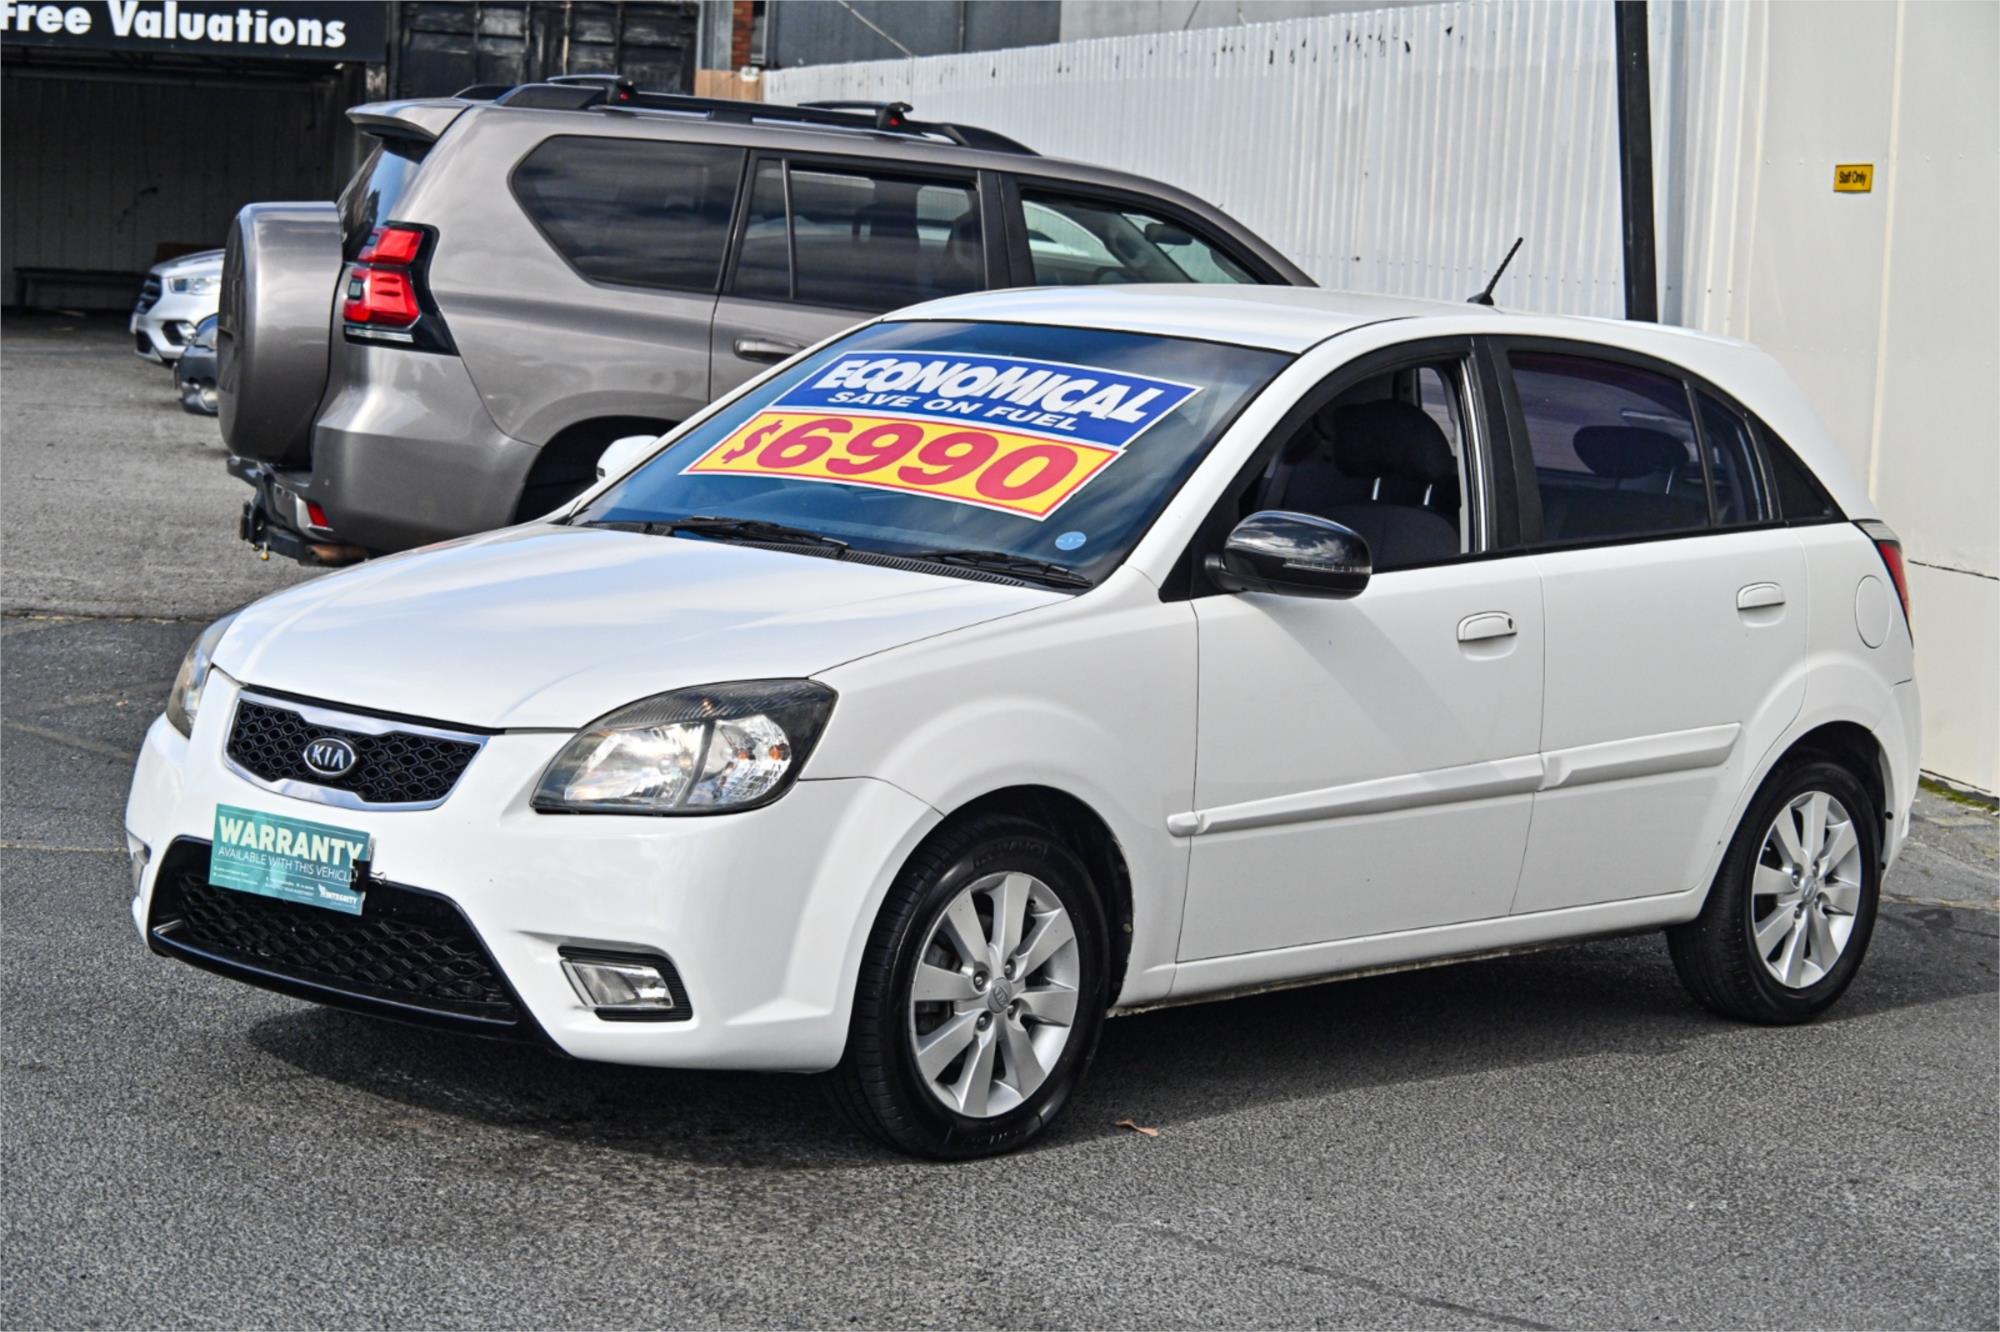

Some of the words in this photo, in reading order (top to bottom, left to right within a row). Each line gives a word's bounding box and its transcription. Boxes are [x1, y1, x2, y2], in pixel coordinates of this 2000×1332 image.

[107, 0, 346, 47] Valuations
[812, 358, 1164, 424] ECONOMICAL
[827, 391, 921, 408] SAVE
[922, 398, 987, 415] ON
[983, 406, 1078, 432] FUEL
[721, 418, 1079, 501] $6990
[311, 744, 344, 769] KIA
[218, 846, 267, 866] AVAILABLE
[268, 856, 293, 871] WITH
[294, 861, 315, 875] THIS
[219, 816, 363, 868] WARRANTY
